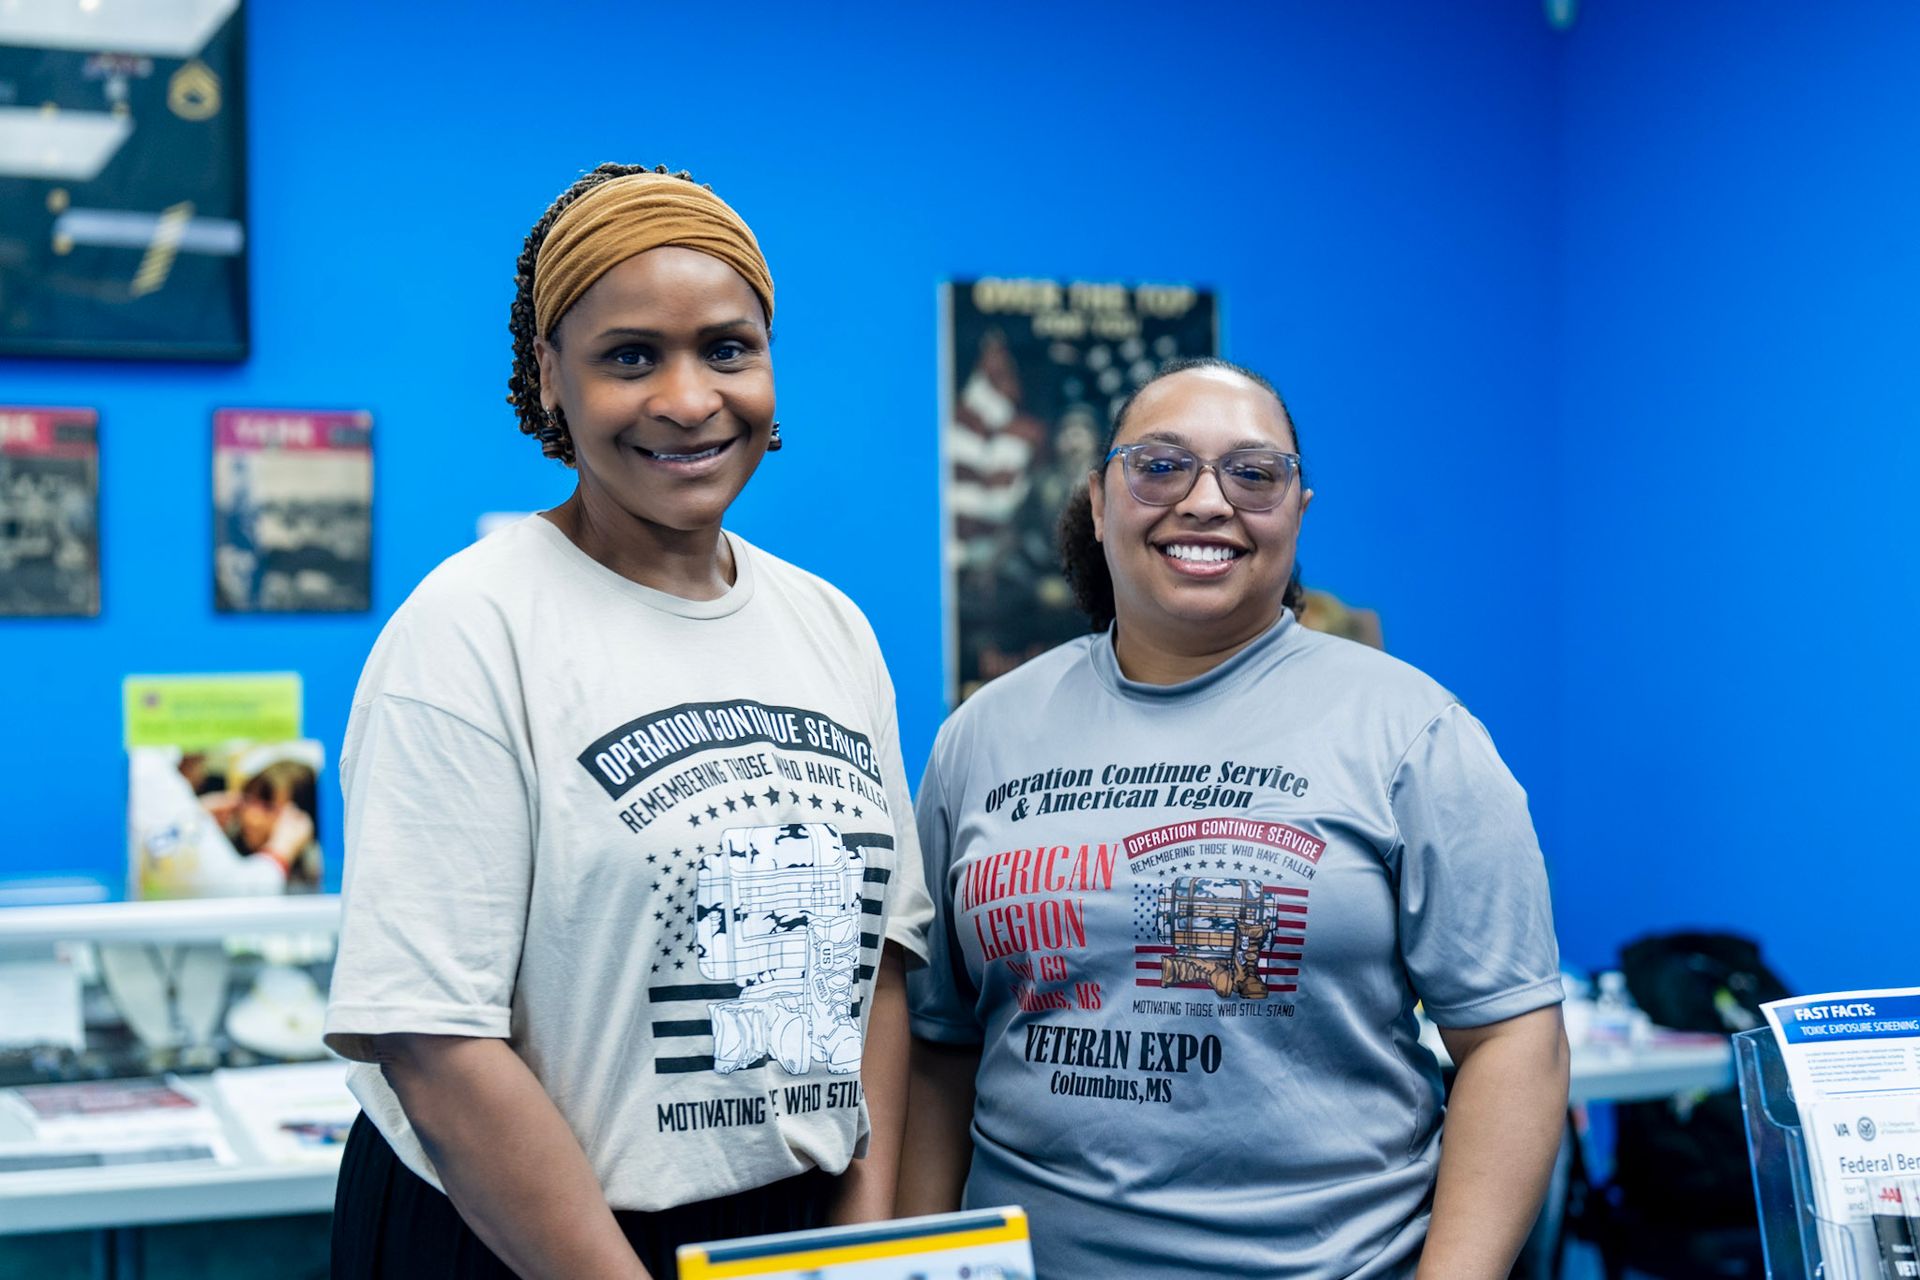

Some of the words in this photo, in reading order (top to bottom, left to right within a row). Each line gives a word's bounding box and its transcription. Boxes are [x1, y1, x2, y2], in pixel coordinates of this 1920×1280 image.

[595, 709, 712, 786] OPERATION
[705, 705, 802, 746] CONTINUE
[804, 717, 879, 777] SERVICE
[618, 759, 728, 834] REMEMBERING
[724, 752, 773, 781] THOSE
[772, 752, 802, 781] WHO
[805, 761, 845, 789] HAVE
[848, 771, 890, 818] FALLEN
[985, 765, 1093, 814] Operation
[1101, 762, 1211, 785] Continue
[1217, 760, 1309, 798] Service
[1011, 797, 1030, 822] &
[1036, 784, 1159, 816] American
[1163, 783, 1254, 811] Legion
[1128, 823, 1197, 854] OPERATION
[1201, 820, 1265, 839] CONTINUE
[1267, 826, 1321, 860] SERVICE
[961, 843, 1120, 914] AMERICAN
[1130, 845, 1195, 875] REMEMBERING
[1199, 843, 1228, 855] THOSE
[1232, 844, 1254, 857] WHO
[1256, 847, 1280, 864] HAVE
[1282, 856, 1317, 881] FALLEN
[974, 898, 1087, 962] LEGION
[1039, 955, 1068, 982] 69
[1075, 982, 1102, 1010] MS
[1132, 1000, 1181, 1016] MOTIVATING
[1184, 1002, 1213, 1017] THOSE
[1217, 1002, 1237, 1017] WHO
[1239, 1002, 1262, 1017] STILL
[1267, 1004, 1295, 1018] STAND
[1794, 1006, 1829, 1020] FAST
[1830, 1003, 1876, 1017] FACTS:
[1800, 1024, 1828, 1035] TOXIC
[1829, 1022, 1873, 1034] EXPOSURE
[1873, 1020, 1920, 1032] SCREENING
[1024, 1023, 1131, 1070] VETERAN
[1138, 1031, 1222, 1074] EXPO
[657, 1097, 766, 1132] MOTIVATING
[784, 1084, 822, 1115] WHO
[826, 1080, 863, 1109] STIL
[1833, 1123, 1850, 1137] VA
[1839, 1154, 1893, 1174] Federal
